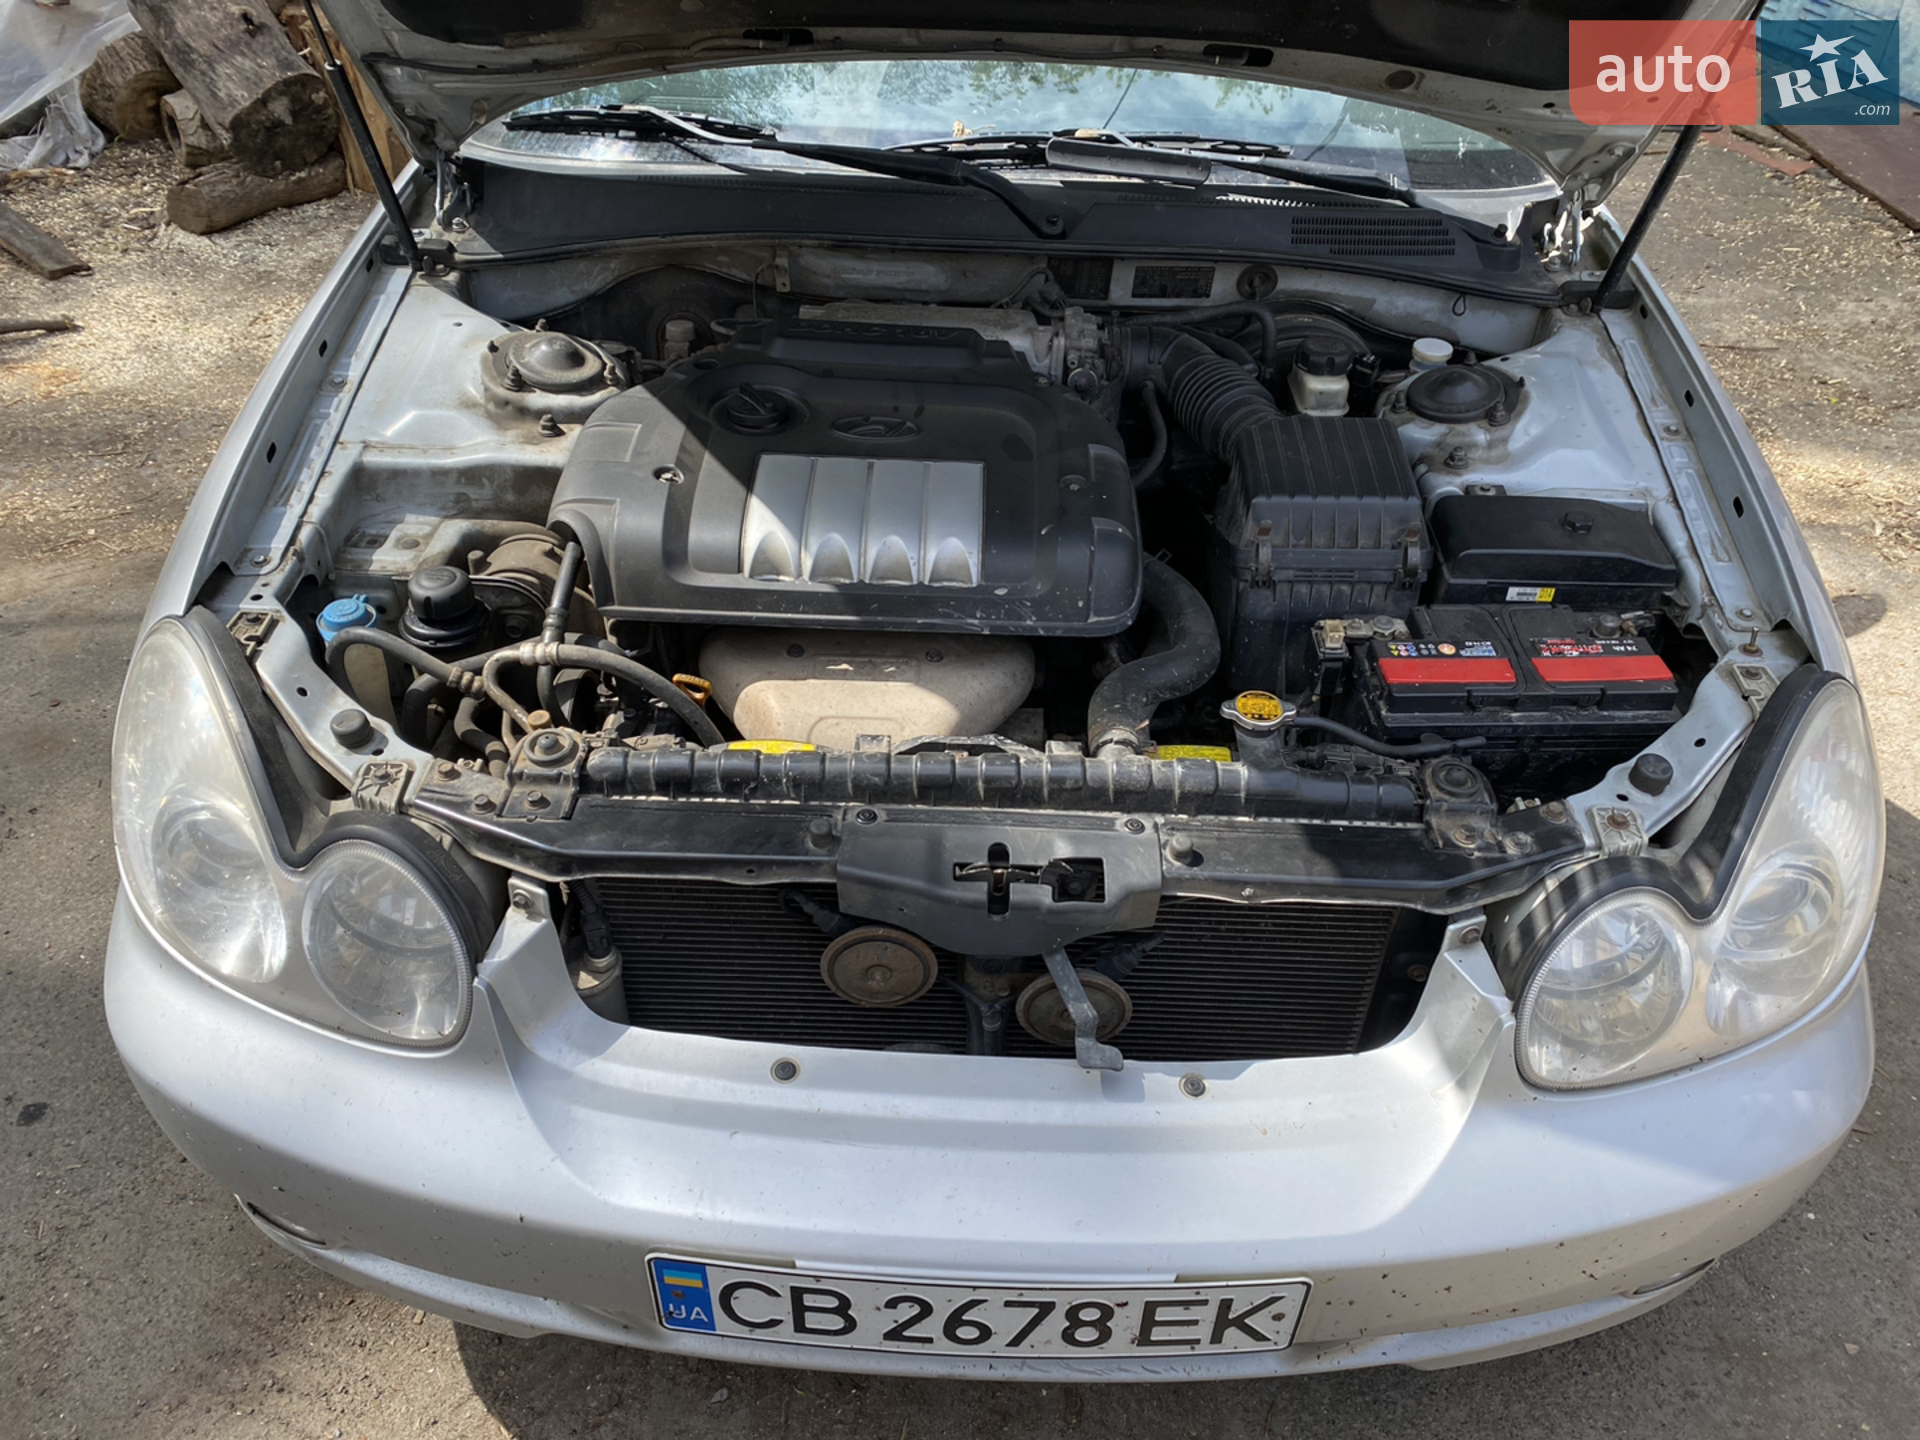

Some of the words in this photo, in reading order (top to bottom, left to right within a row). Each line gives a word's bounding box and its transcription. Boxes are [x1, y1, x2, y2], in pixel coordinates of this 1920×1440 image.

[667, 1302, 709, 1323] UA
[718, 1280, 858, 1337] CB
[882, 1294, 1116, 1348] 2678
[1136, 1295, 1288, 1347] EK
